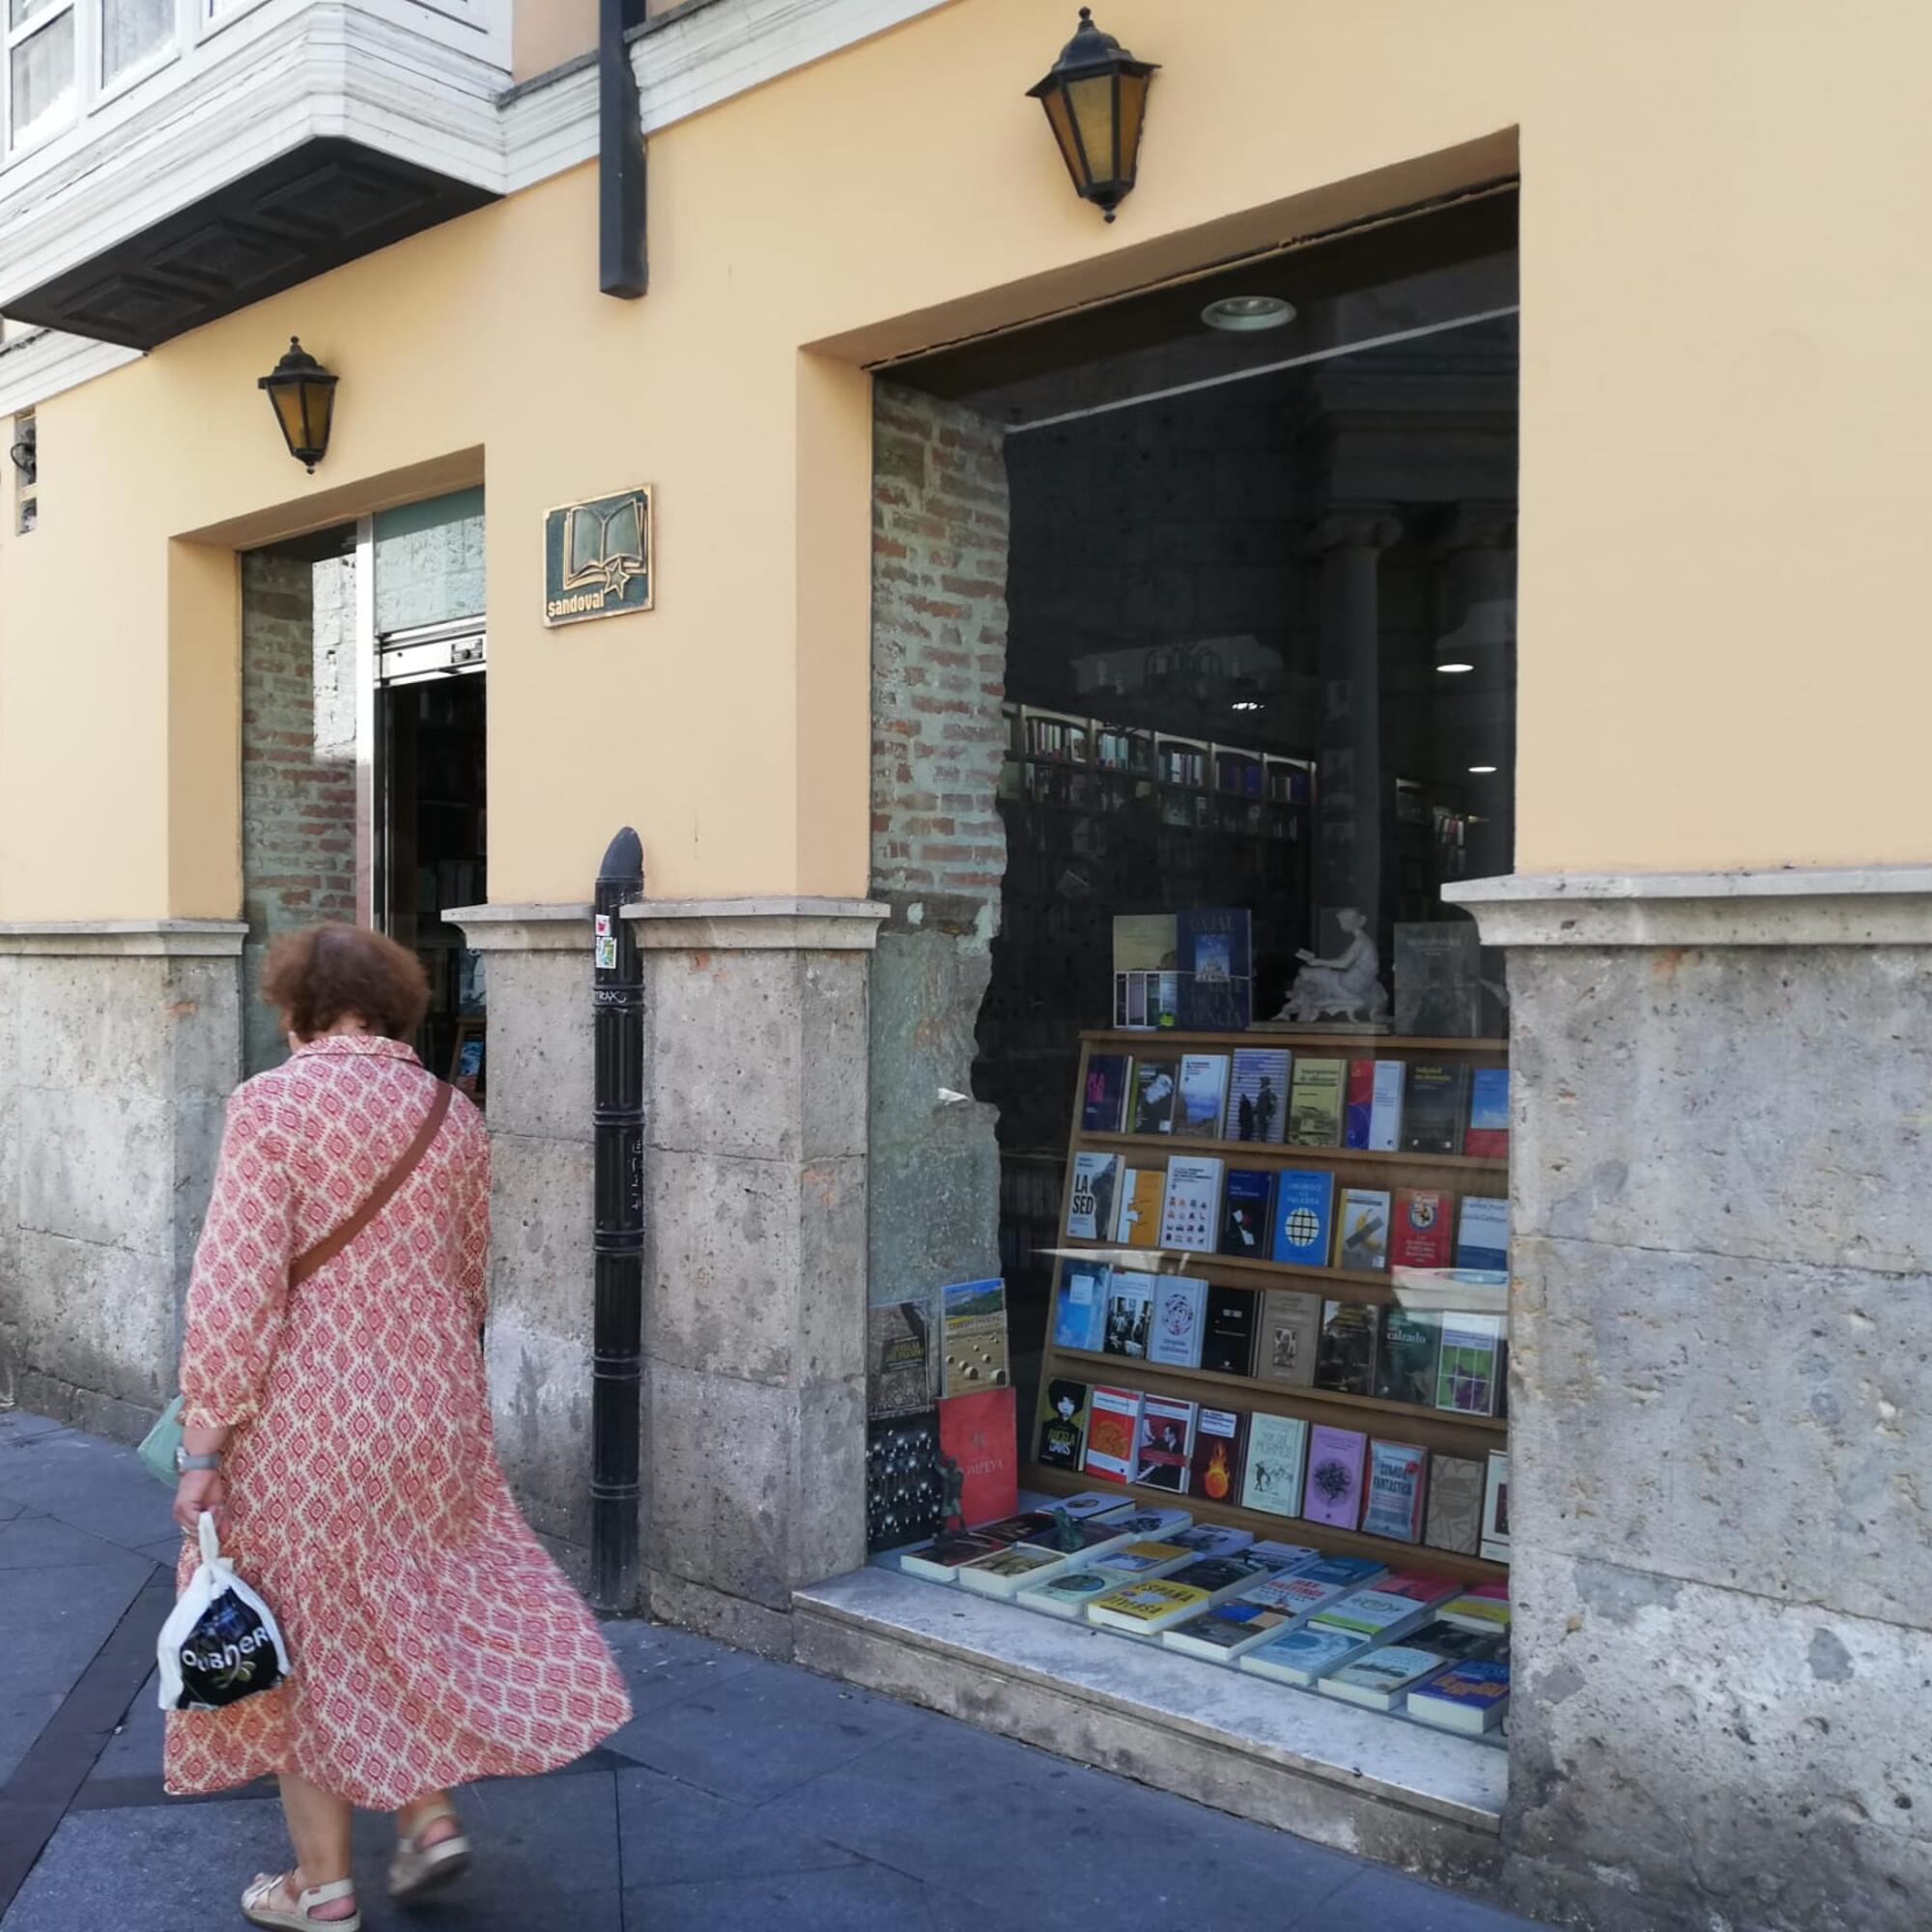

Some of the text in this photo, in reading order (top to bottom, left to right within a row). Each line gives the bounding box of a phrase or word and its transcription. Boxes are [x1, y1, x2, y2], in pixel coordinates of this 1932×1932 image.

[549, 589, 604, 617] sandoval
[1075, 1174, 1089, 1194] LA
[1072, 1195, 1094, 1215] SED
